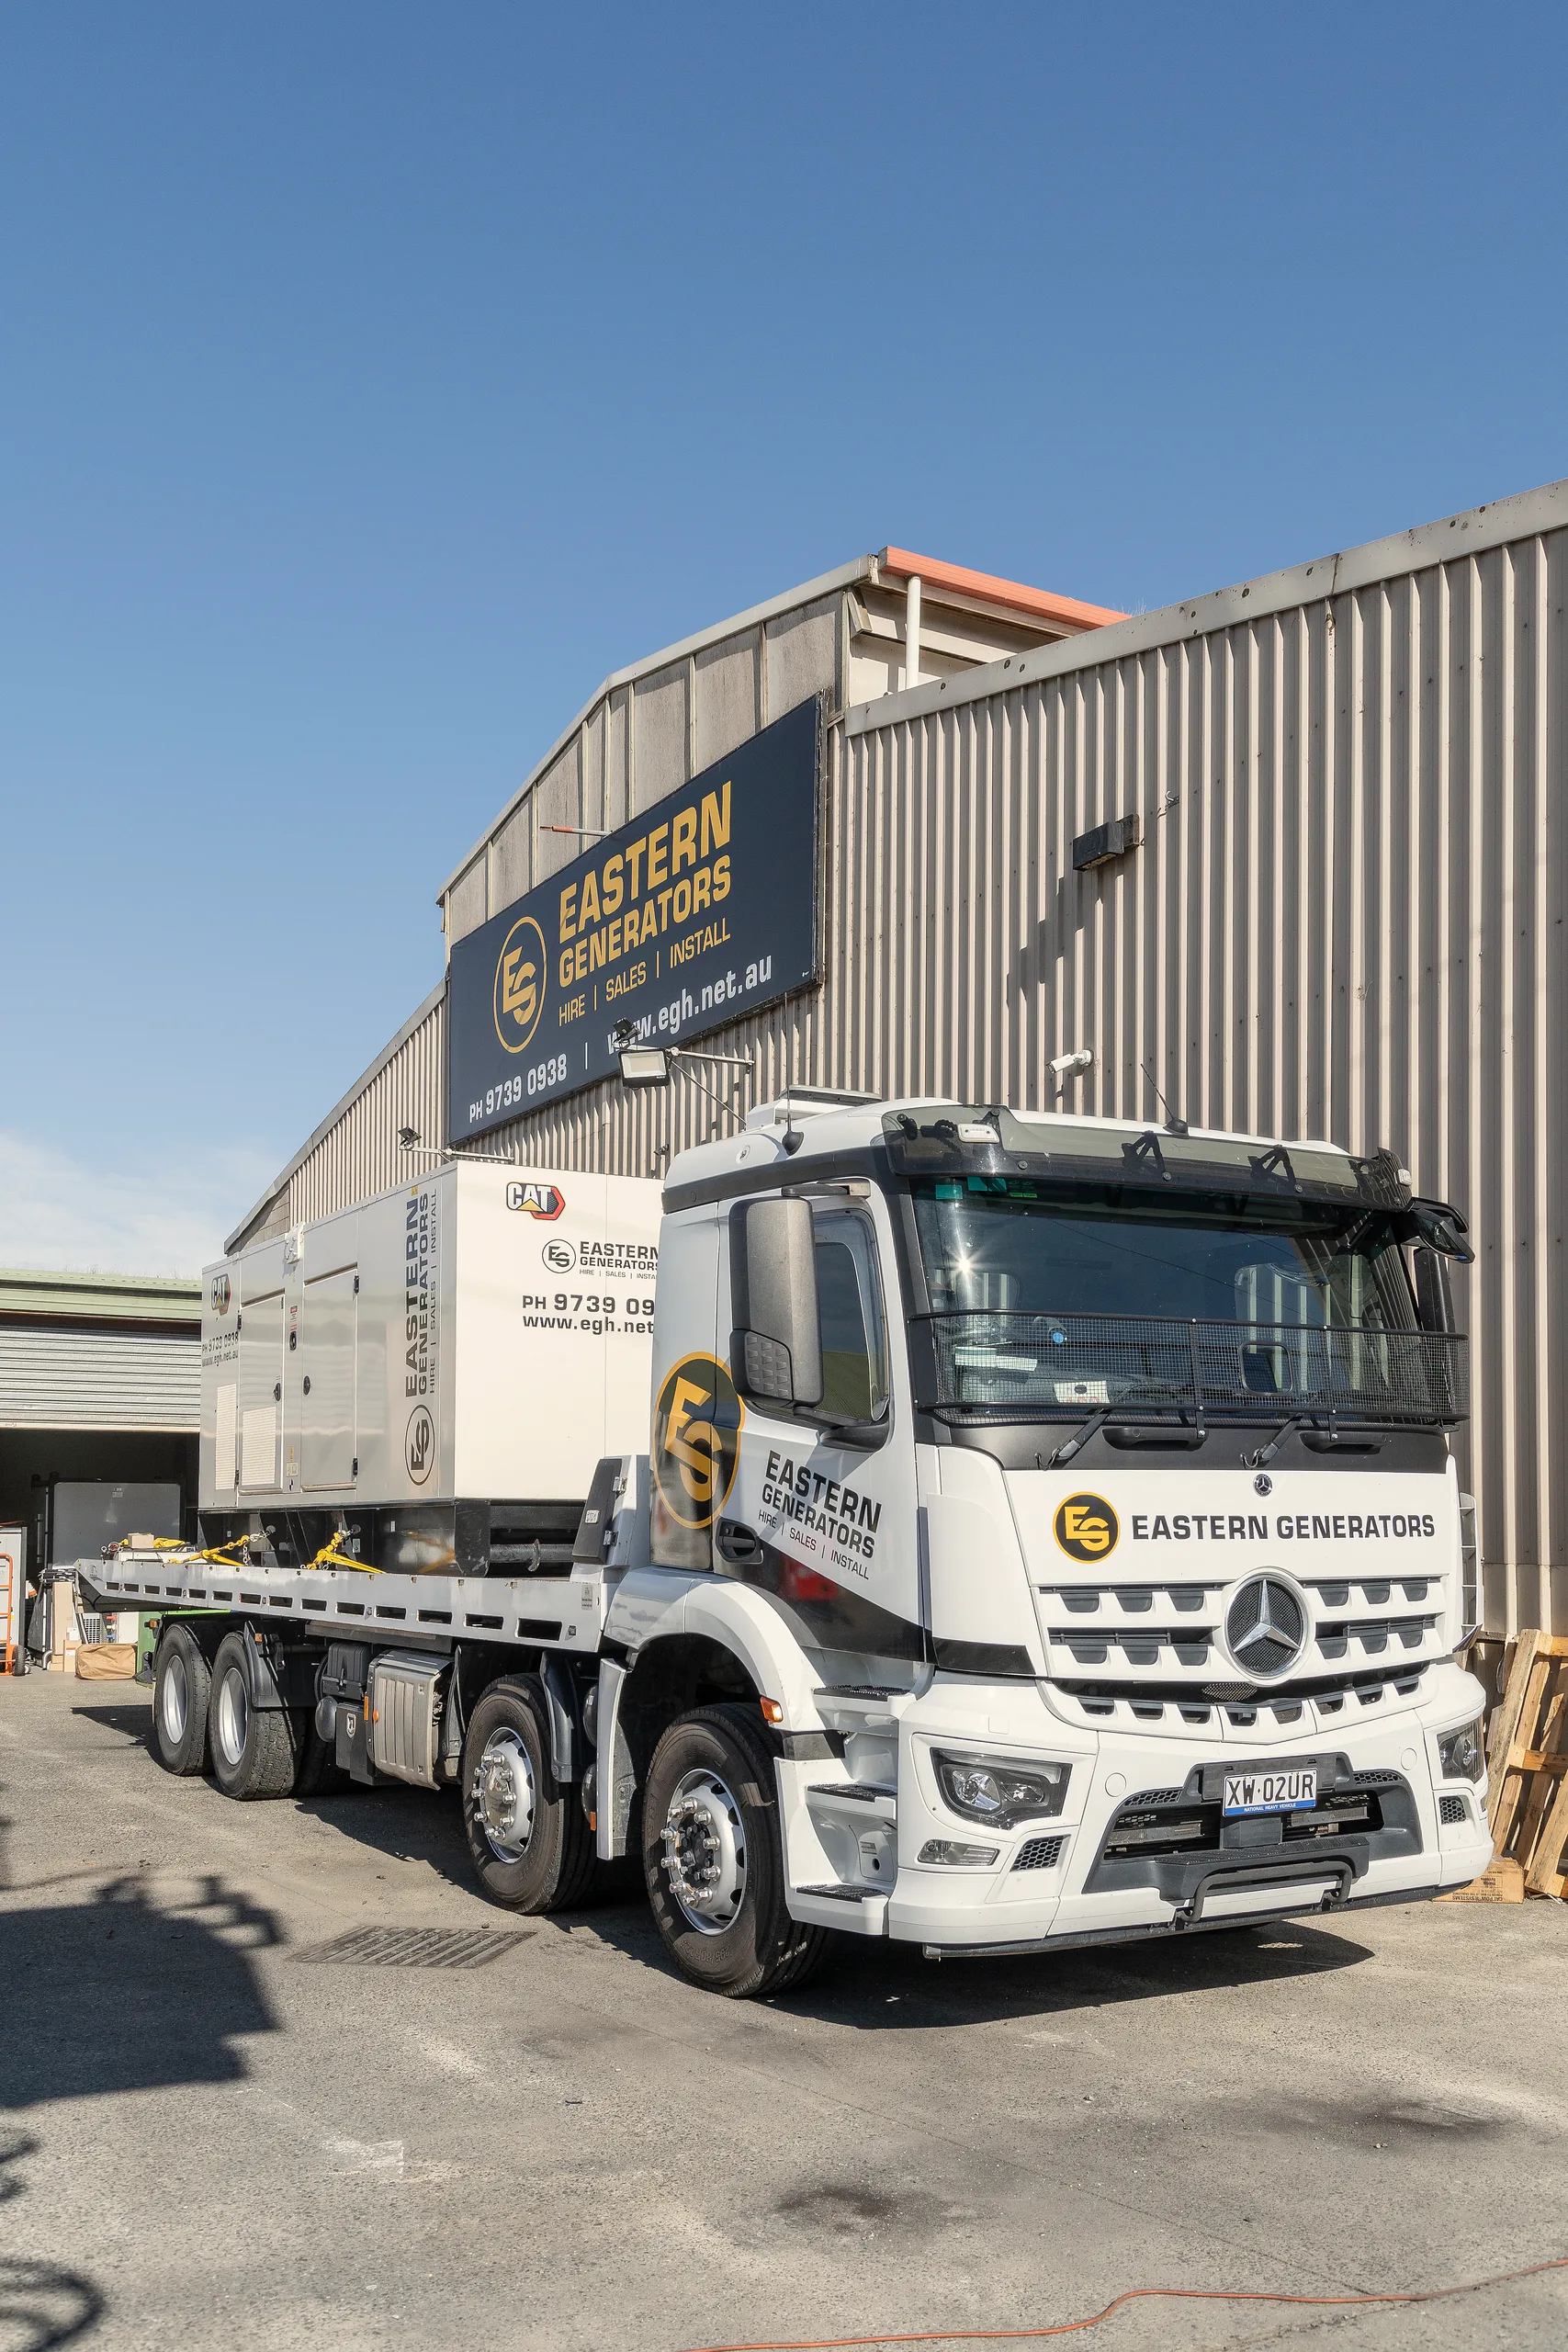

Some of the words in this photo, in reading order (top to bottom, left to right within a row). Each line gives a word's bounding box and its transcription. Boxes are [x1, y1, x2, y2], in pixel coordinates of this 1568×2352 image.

[559, 780, 732, 944] EASTERN
[558, 854, 731, 988] GENERATORS
[558, 994, 585, 1027] HIRE
[605, 961, 646, 1001] SALES
[670, 918, 730, 969] INSTALL
[607, 956, 771, 1055] ww.egh.net.au
[469, 1101, 483, 1124] PH
[486, 1076, 522, 1116] 9739
[527, 1053, 568, 1096] 0938
[507, 1182, 551, 1213] CAT
[212, 1275, 227, 1307] CAT
[405, 1197, 418, 1397] EASTERN
[419, 1193, 429, 1396] GENERATORS
[523, 1295, 547, 1309] PH
[554, 1294, 615, 1314] 9739
[761, 1483, 875, 1559] GENERATORS
[764, 1450, 883, 1534] EASTERN
[1132, 1514, 1268, 1540] EASTERN
[1276, 1513, 1436, 1539] GENERATORS
[758, 1509, 777, 1530] HIRE
[789, 1527, 817, 1552] SALES
[830, 1550, 869, 1580] INSTALL
